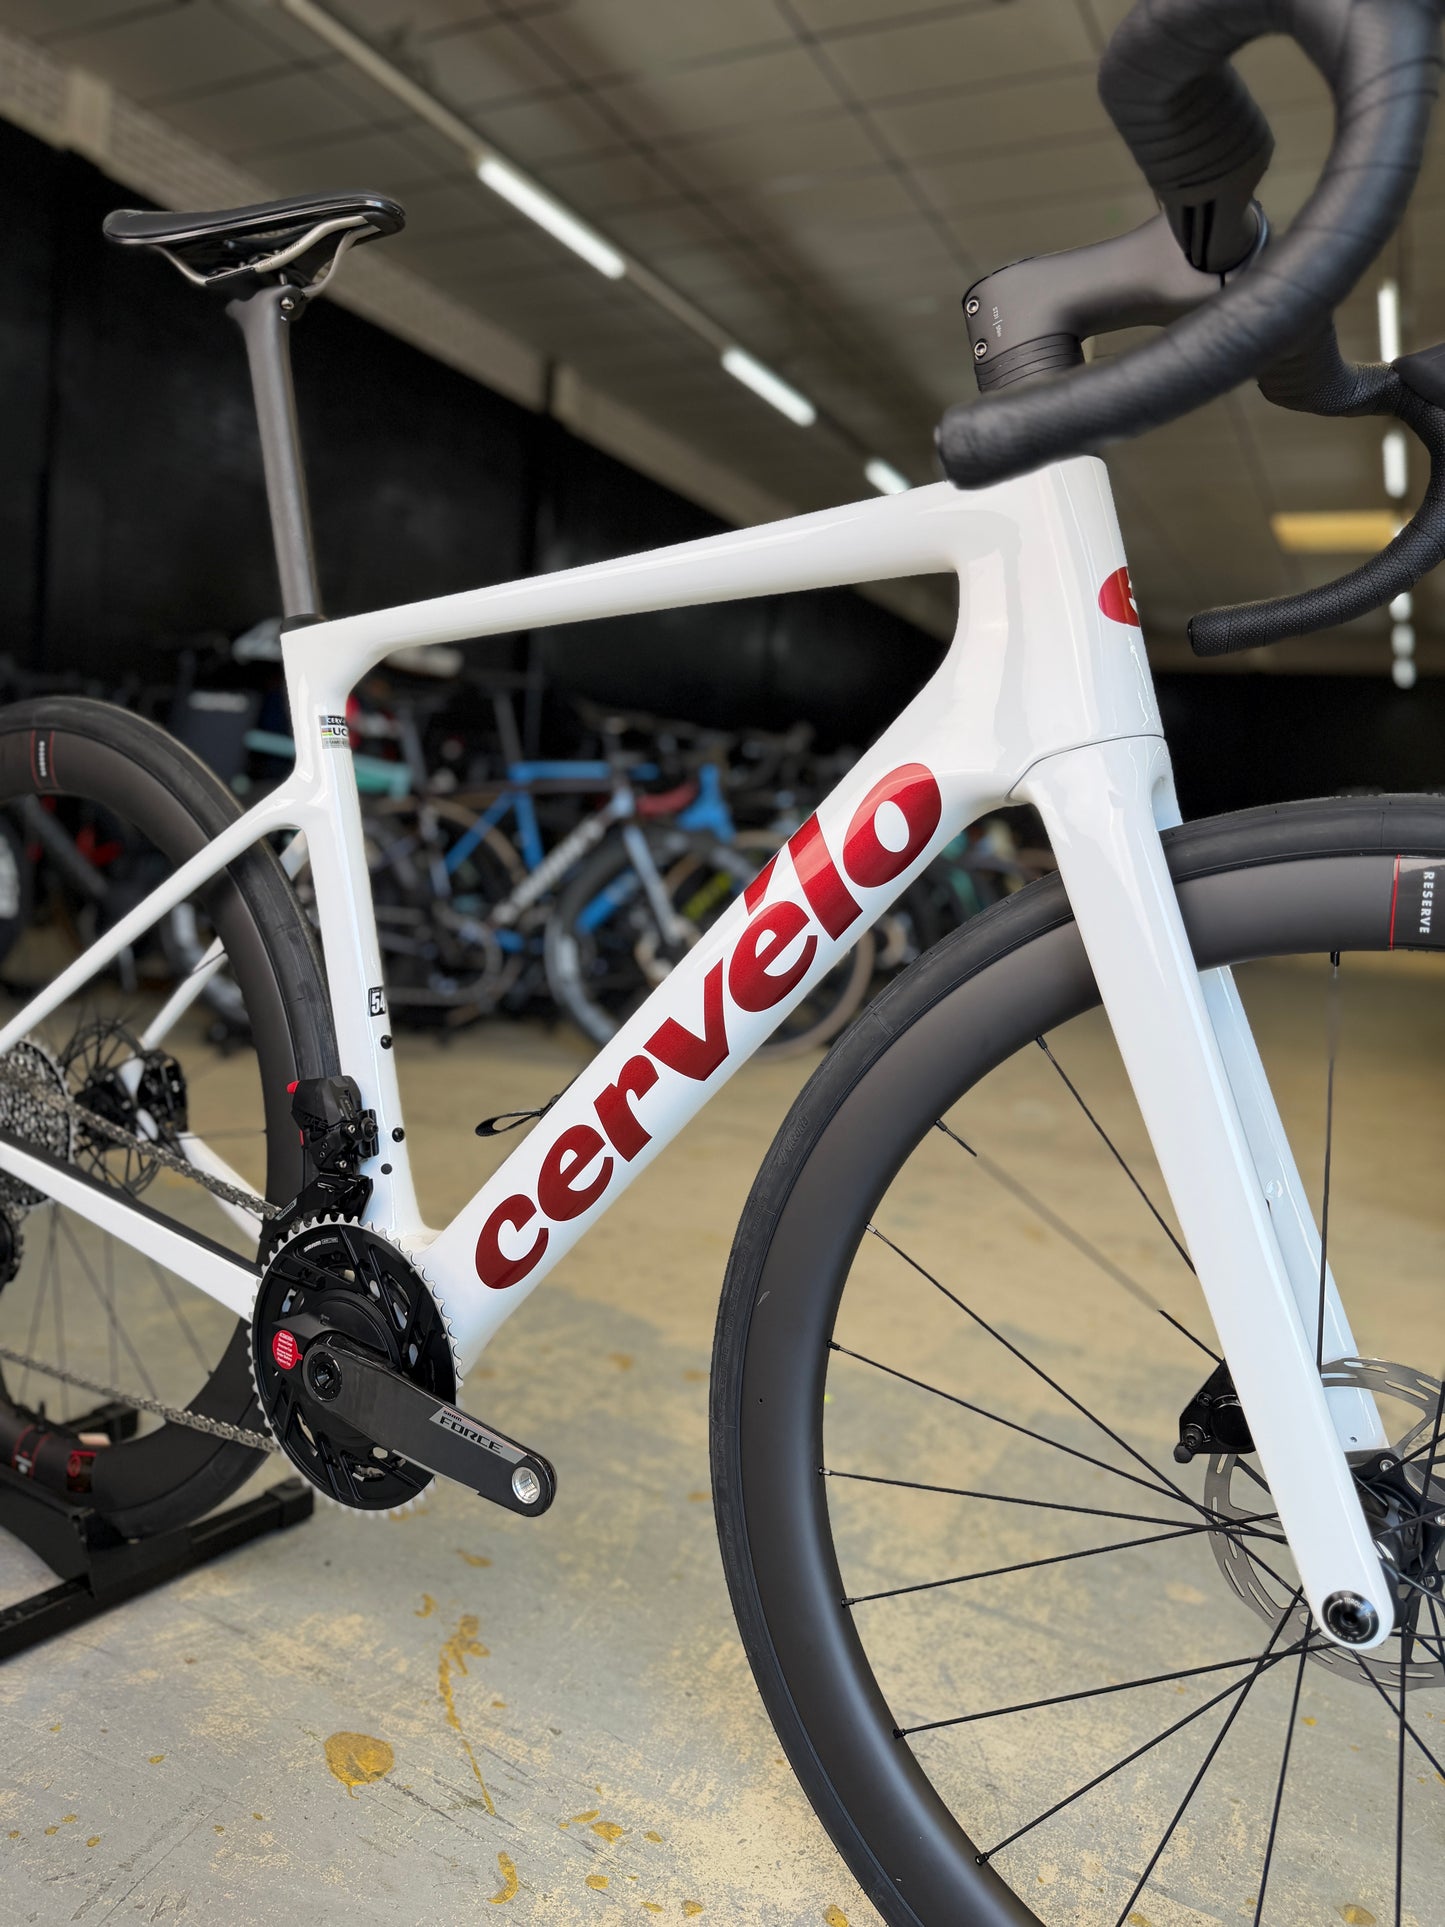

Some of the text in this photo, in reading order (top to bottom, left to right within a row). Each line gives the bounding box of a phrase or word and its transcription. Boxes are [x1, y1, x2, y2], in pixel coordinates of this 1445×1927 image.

[1419, 871, 1436, 934] RESERVE
[474, 762, 942, 1290] cervélo
[439, 1415, 504, 1454] FORCE
